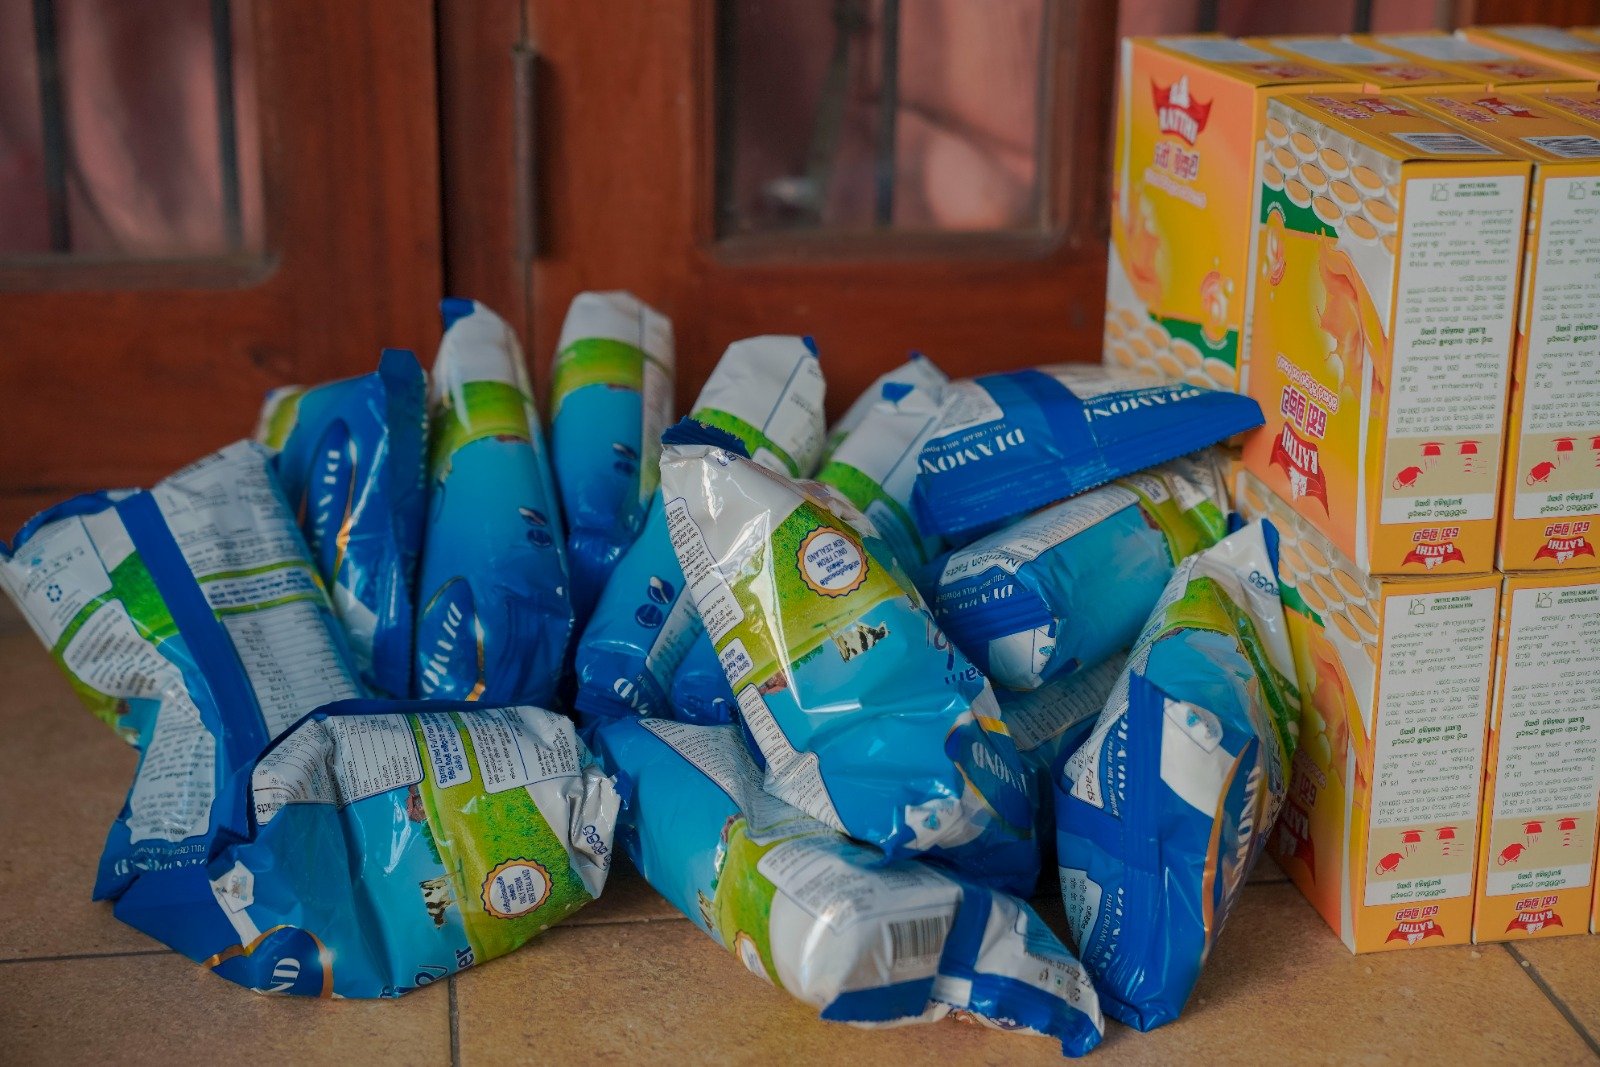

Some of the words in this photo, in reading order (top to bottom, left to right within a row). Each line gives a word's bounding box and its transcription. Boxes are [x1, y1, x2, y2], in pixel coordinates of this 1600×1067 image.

[1281, 426, 1318, 475] RATTHI
[832, 537, 845, 548] NEW
[1415, 542, 1454, 557] RATTHI
[1547, 537, 1586, 552] RATTHI
[806, 543, 833, 562] ZEALAND
[832, 546, 847, 559] ONLY
[815, 555, 833, 567] FROM
[945, 561, 970, 578] Facts
[433, 748, 441, 763] Dried
[348, 760, 358, 796] Phosphorus
[438, 765, 446, 783] Spray
[1085, 767, 1095, 801] Facts
[514, 876, 522, 891] FROM
[522, 869, 534, 891] ZEALAND
[518, 892, 526, 904] ONLY
[1517, 910, 1555, 924] RATTHI
[1099, 914, 1109, 941] CREAM
[1398, 921, 1435, 934] RATTHI
